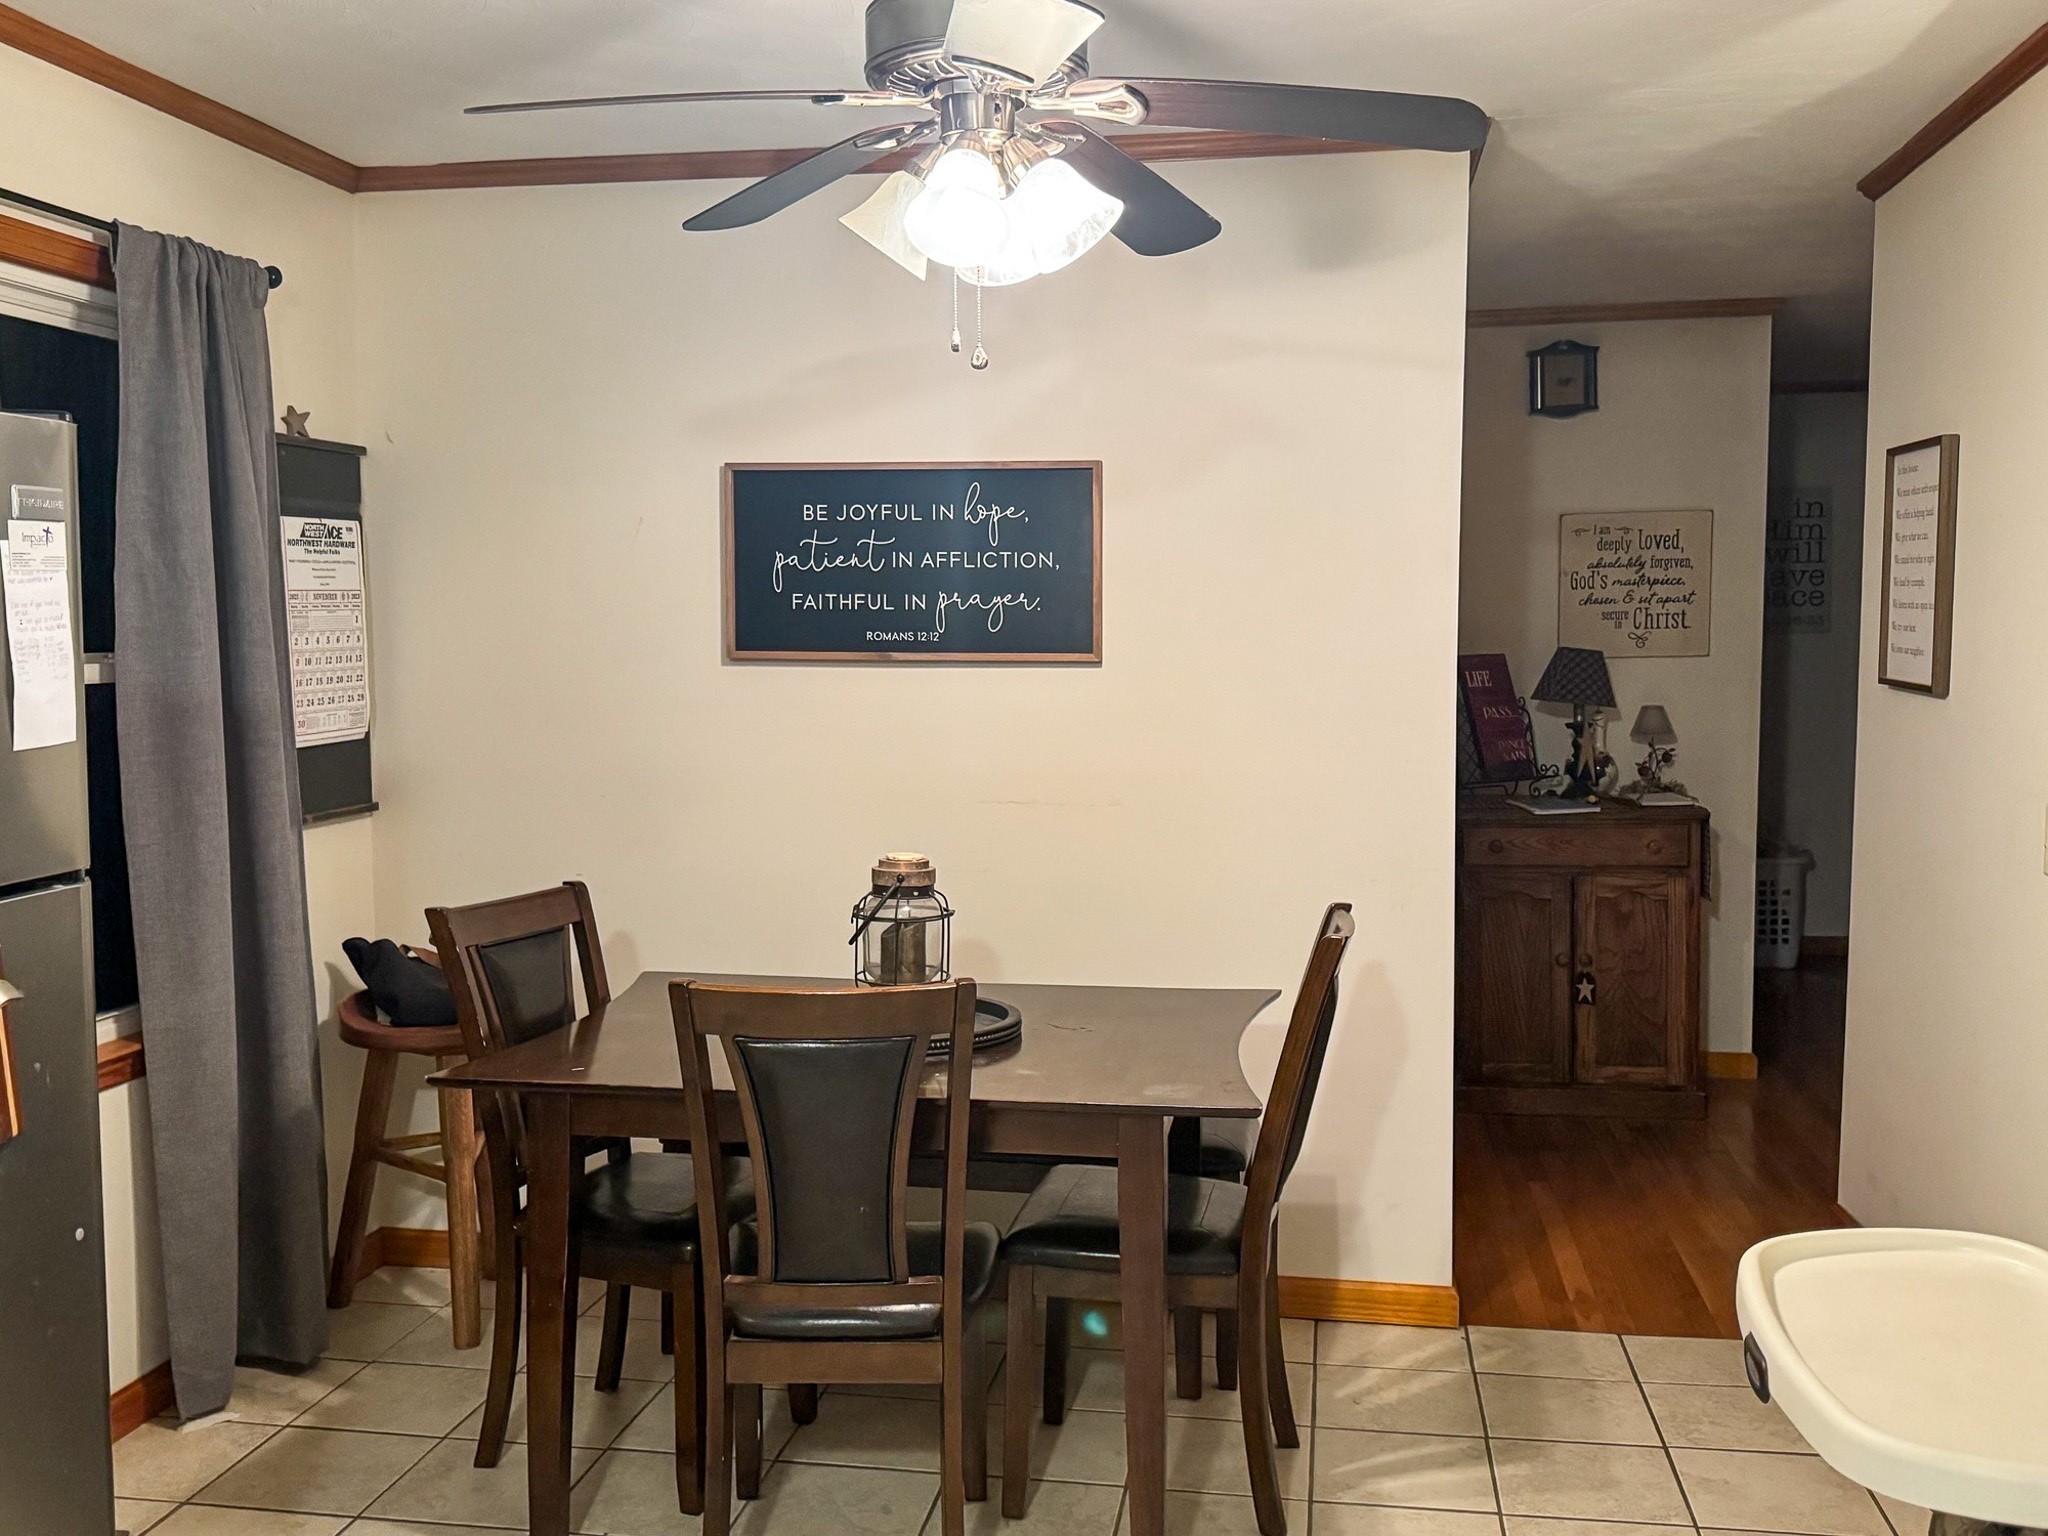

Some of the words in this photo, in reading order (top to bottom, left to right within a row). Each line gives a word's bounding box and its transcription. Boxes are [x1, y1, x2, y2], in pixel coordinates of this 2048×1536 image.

[803, 504, 828, 521] BE
[836, 504, 922, 521] JOYFUL
[932, 504, 954, 521] IN
[964, 481, 1029, 546] hope,
[324, 524, 343, 539] ACE
[1593, 524, 1597, 535] I
[1598, 526, 1611, 535] am
[287, 539, 323, 547] NORTHWEST
[323, 540, 356, 549] HARDWARE
[1597, 536, 1632, 554] deeply
[1638, 528, 1684, 553] loved,
[771, 528, 896, 592] patient
[892, 551, 913, 568] IN
[921, 551, 1060, 571] AFFLICTION,
[1587, 555, 1647, 574] absolutely
[1650, 555, 1694, 571] forgiven,
[1570, 570, 1608, 590] God's
[1770, 569, 1825, 588] ave
[313, 592, 338, 601] NOVEMBER
[1579, 592, 1619, 606] chosen
[1622, 589, 1634, 603] &
[1638, 592, 1655, 606] set
[1656, 590, 1696, 609] apart
[792, 593, 895, 610] FAITHFUL
[904, 593, 926, 610] IN
[935, 590, 1042, 633] prayer.
[1601, 609, 1629, 621] secure
[1615, 620, 1622, 629] in
[866, 631, 914, 641] ROMANS
[917, 631, 940, 641] 12:12
[296, 658, 299, 666] 9
[305, 658, 311, 666] 10
[315, 657, 321, 665] 11
[326, 656, 332, 664] 12
[336, 656, 342, 664] 13
[346, 655, 352, 663] 14
[296, 679, 303, 687] 16
[306, 678, 312, 686] 17
[346, 675, 352, 683] 21
[356, 674, 363, 682] 22
[1465, 670, 1492, 687] LIFE
[296, 699, 303, 708] 23
[307, 699, 314, 707] 24
[317, 697, 325, 705] 25
[338, 696, 345, 704] 27
[348, 695, 354, 703] 28
[297, 720, 305, 728] 30
